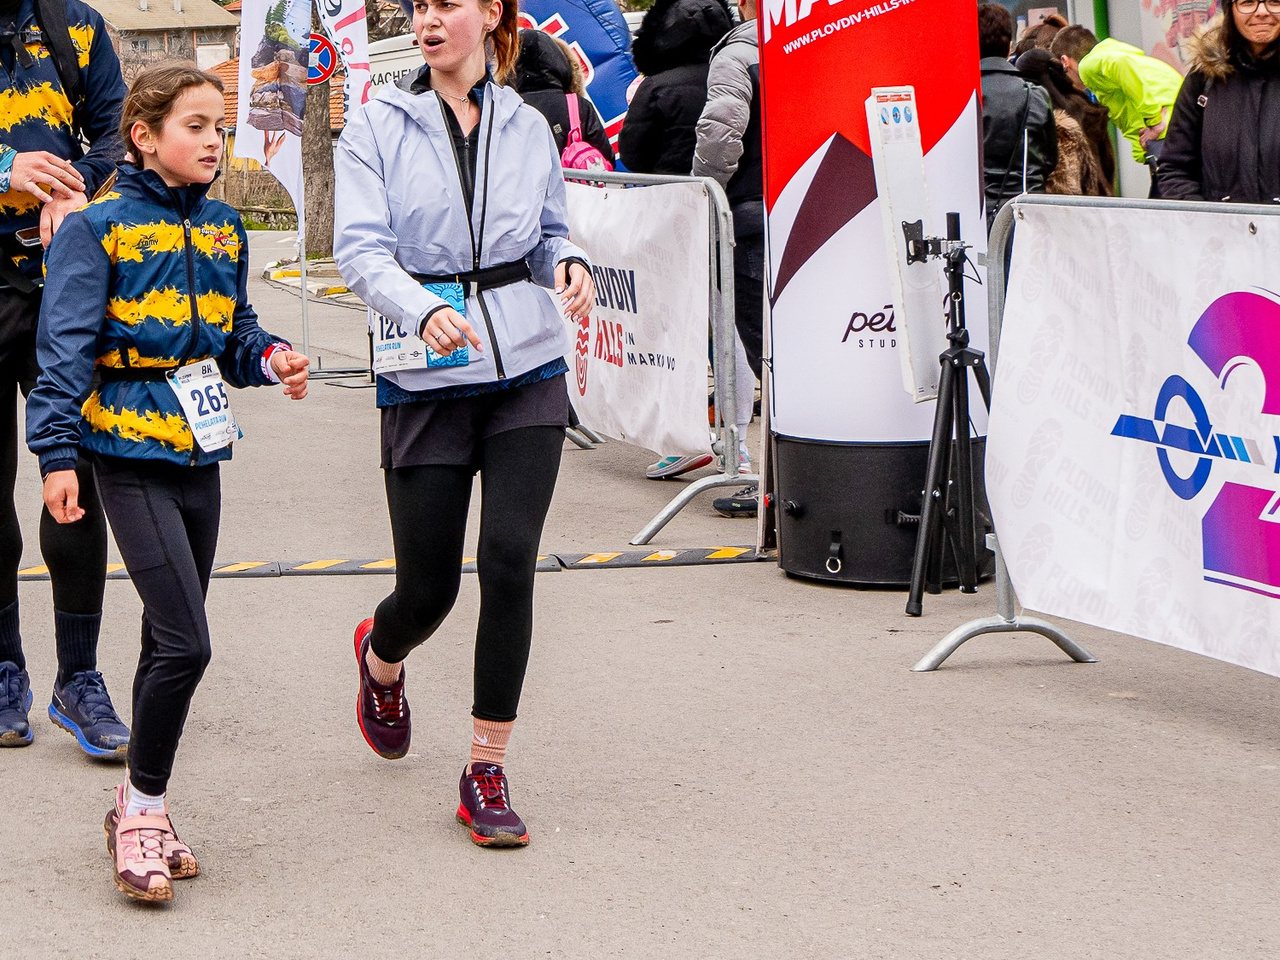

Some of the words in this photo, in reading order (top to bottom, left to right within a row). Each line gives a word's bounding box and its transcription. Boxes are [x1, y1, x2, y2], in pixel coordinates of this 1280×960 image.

[370, 69, 412, 86] KACHE
[592, 264, 638, 315] OVDIV
[625, 331, 635, 345] IN
[859, 340, 897, 348] STUD
[627, 352, 676, 372] MARKOVO
[190, 382, 229, 417] 265
